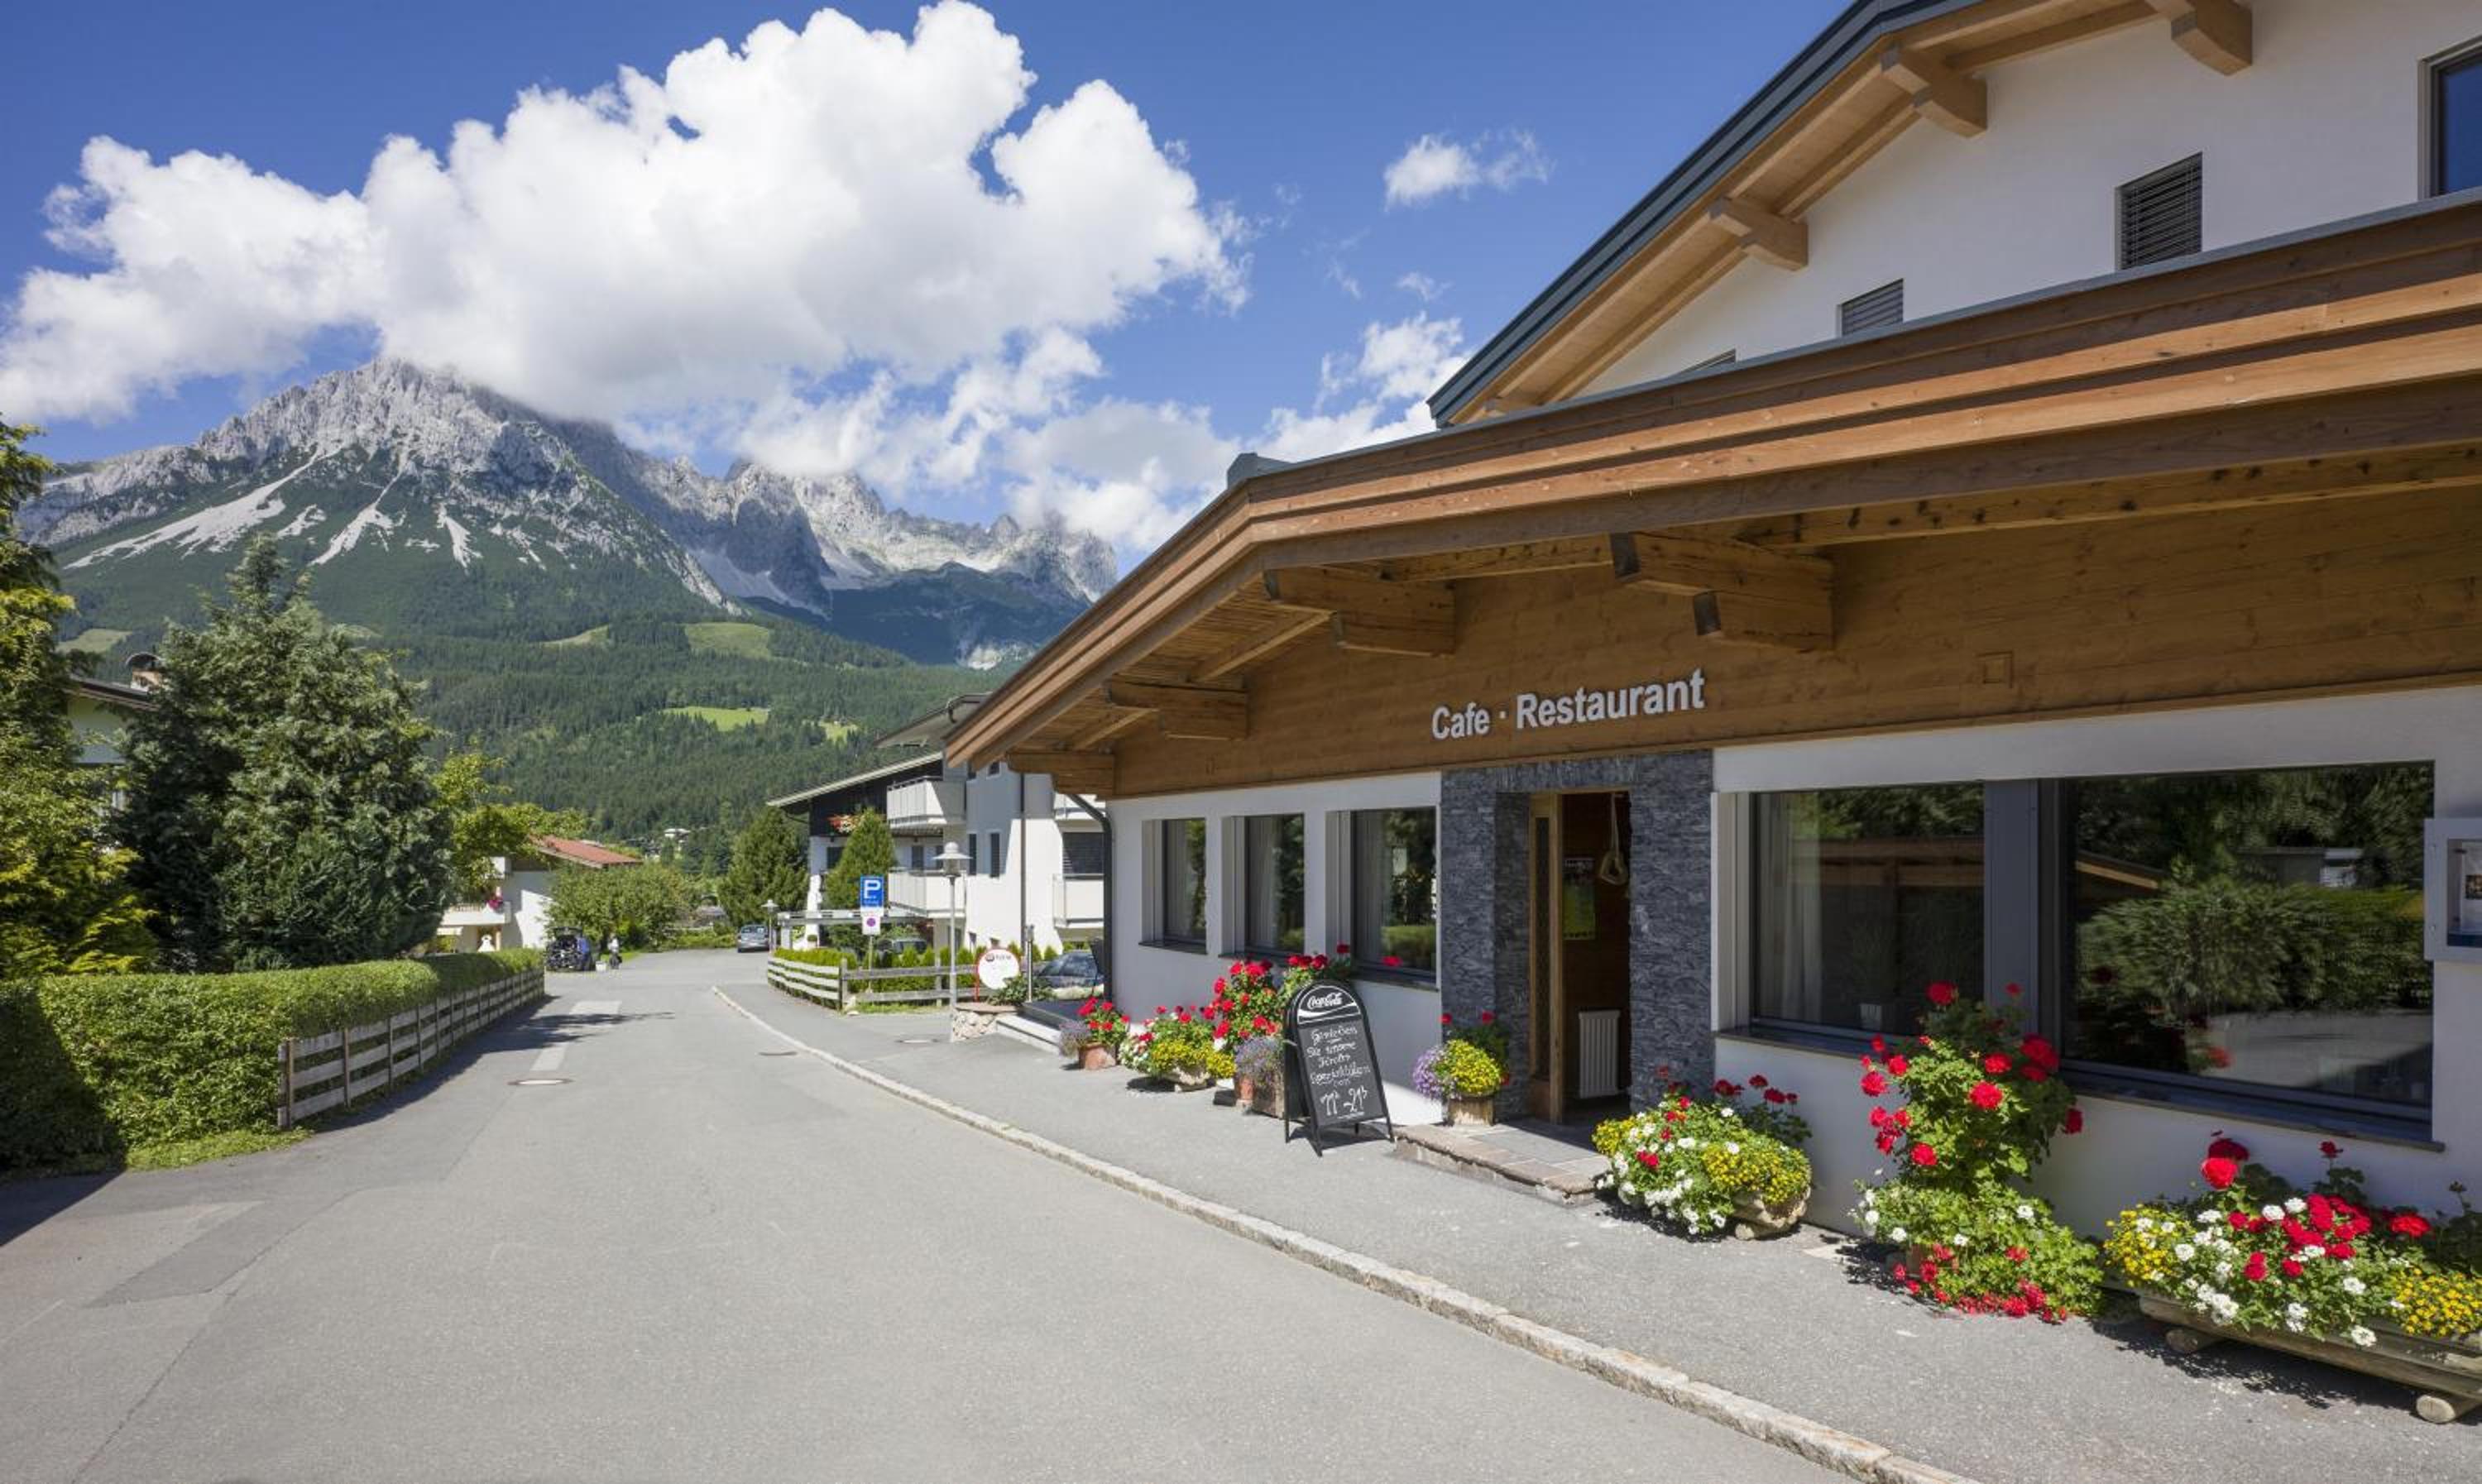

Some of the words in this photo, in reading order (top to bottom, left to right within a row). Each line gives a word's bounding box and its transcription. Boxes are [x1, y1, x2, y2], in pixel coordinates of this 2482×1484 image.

[1431, 702, 1490, 740] Cafe
[1517, 668, 1706, 730] Restaurant
[864, 879, 881, 899] P
